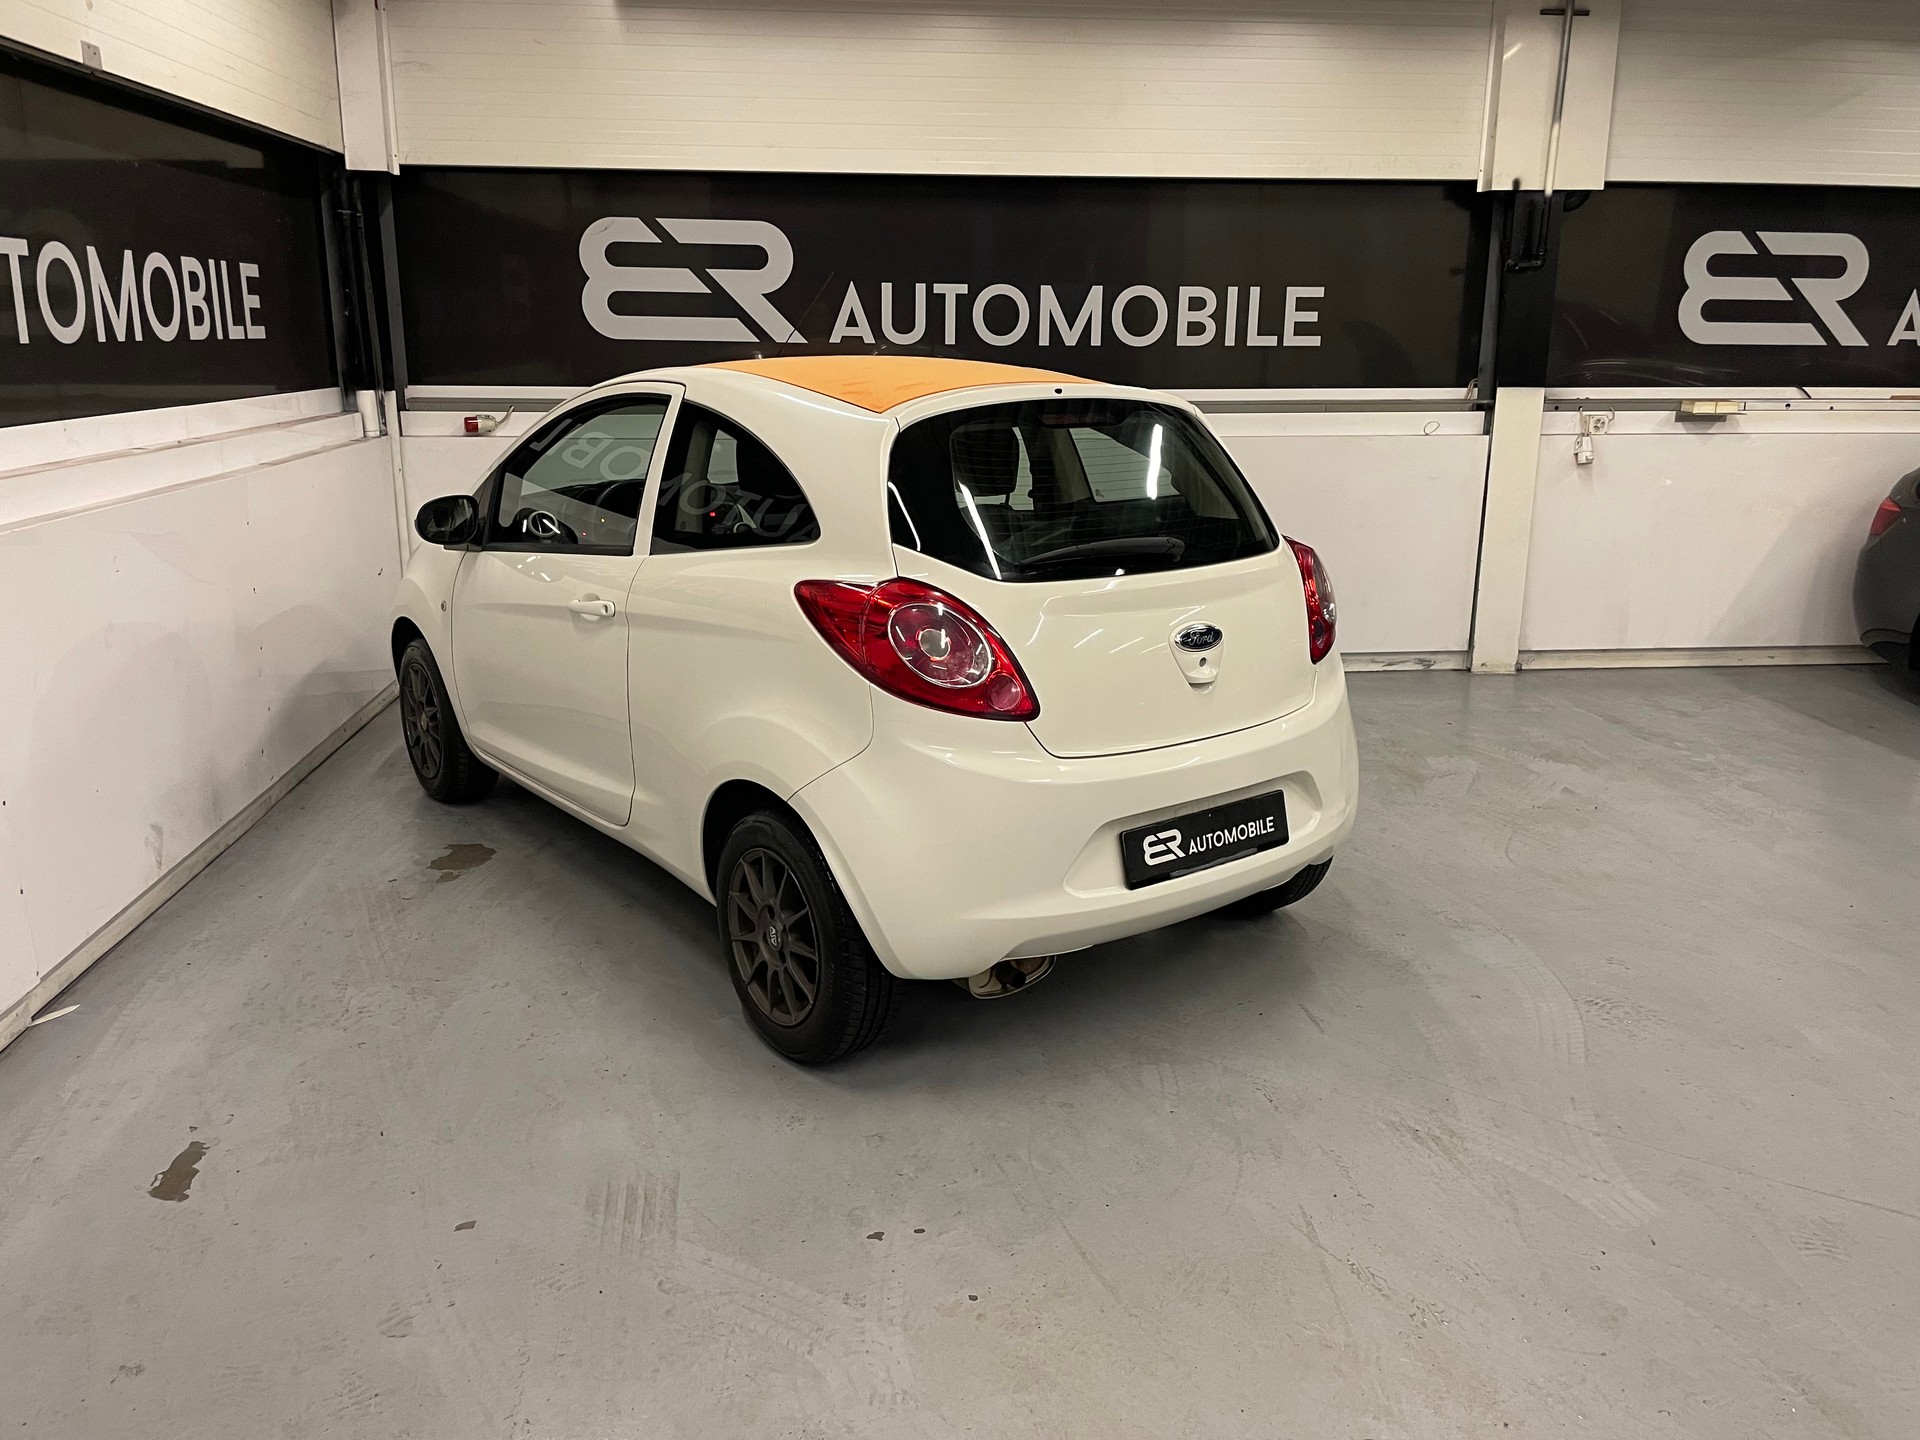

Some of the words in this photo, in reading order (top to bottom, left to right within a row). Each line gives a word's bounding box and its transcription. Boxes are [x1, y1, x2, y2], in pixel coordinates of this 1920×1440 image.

[829, 281, 1324, 347] AUTOMOBILE
[1184, 628, 1214, 646] Ford
[1189, 816, 1275, 855] AUTOMOBILE
